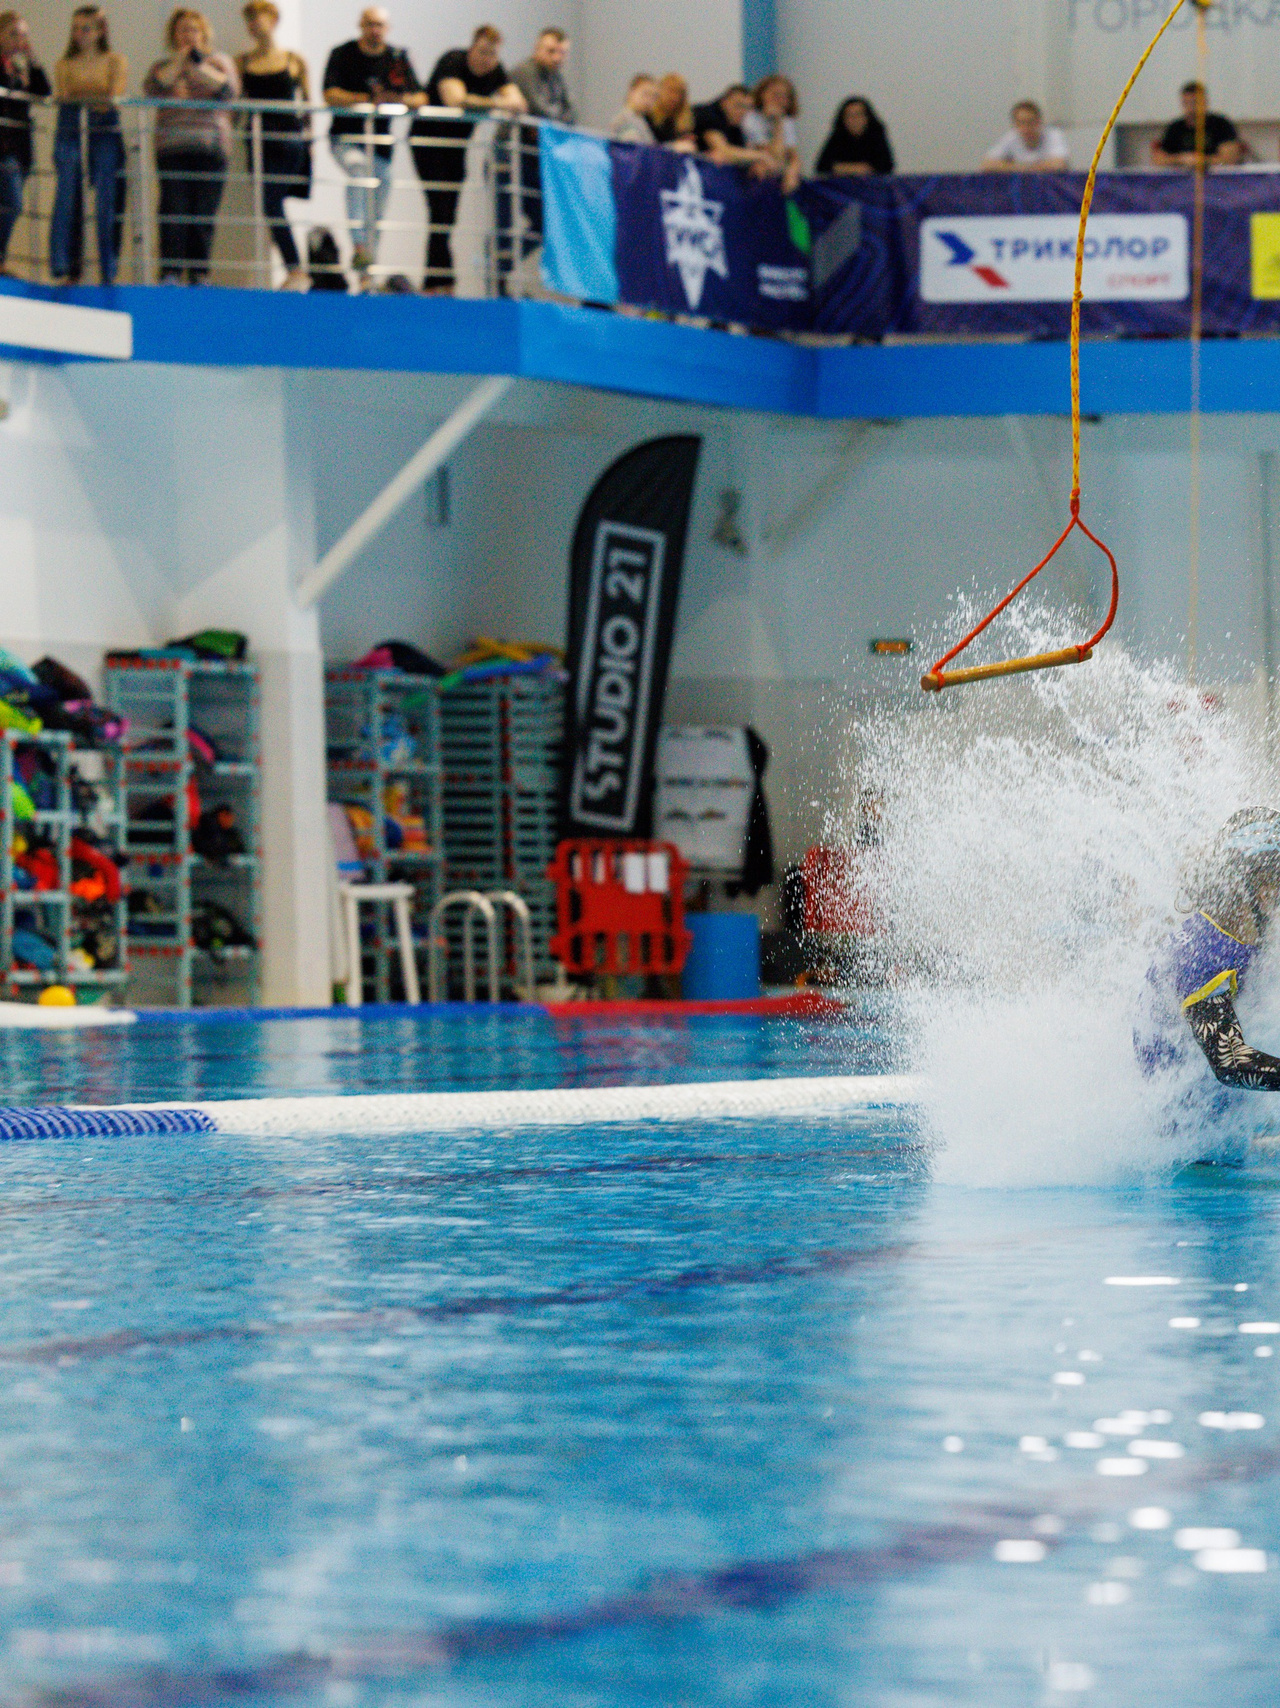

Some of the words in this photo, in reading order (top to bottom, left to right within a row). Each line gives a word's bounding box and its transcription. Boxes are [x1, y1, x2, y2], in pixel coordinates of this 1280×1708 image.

[990, 235, 1171, 260] ТРИКОЛОР
[604, 547, 650, 603] 21
[585, 614, 641, 802] STUDIO
